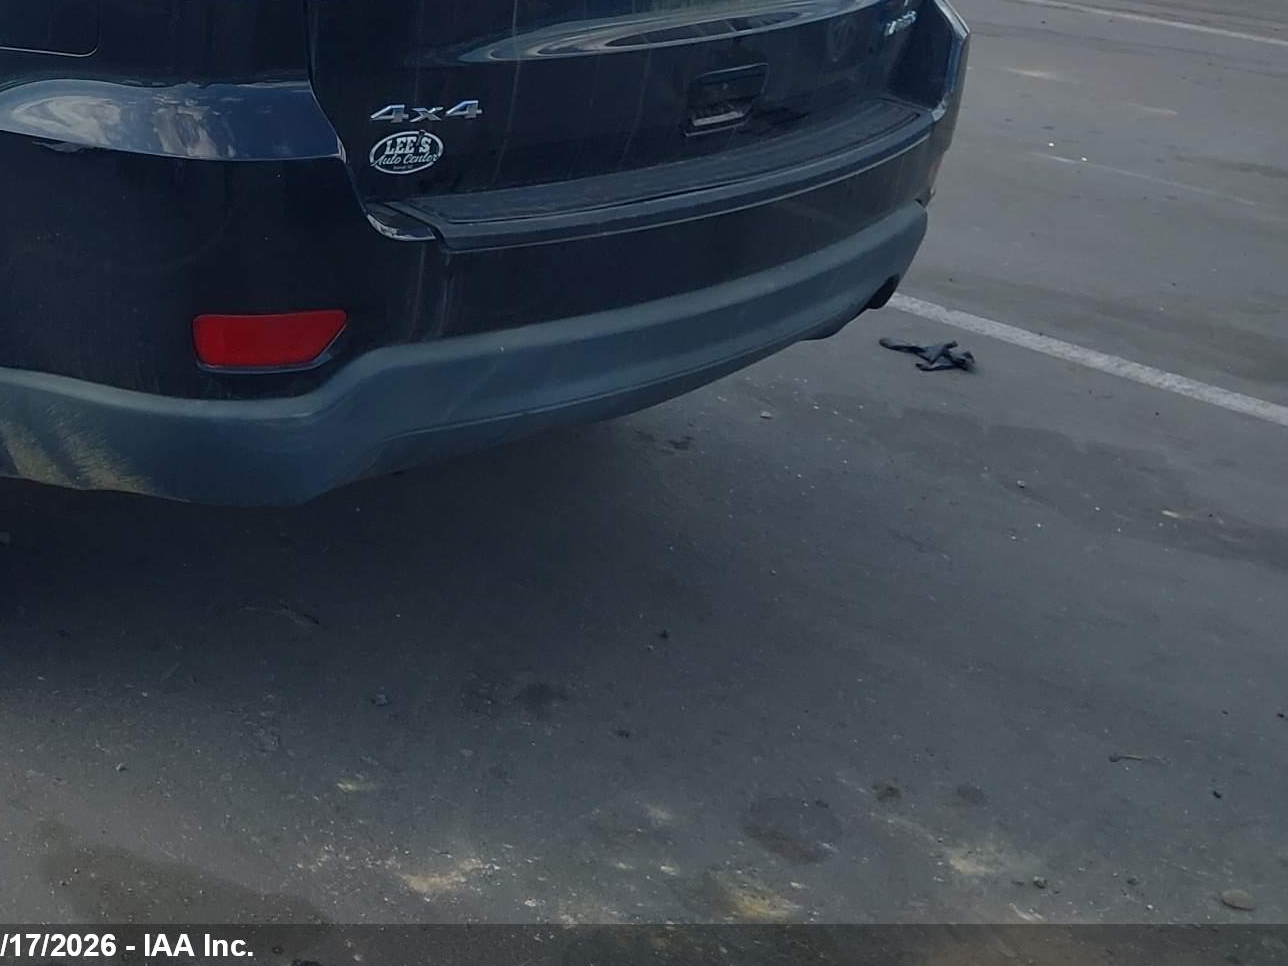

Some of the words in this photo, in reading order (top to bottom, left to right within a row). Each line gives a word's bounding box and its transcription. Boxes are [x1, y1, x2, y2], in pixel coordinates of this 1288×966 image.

[384, 136, 432, 155] LEE'S
[373, 153, 402, 166] Auto
[402, 152, 439, 165] Center
